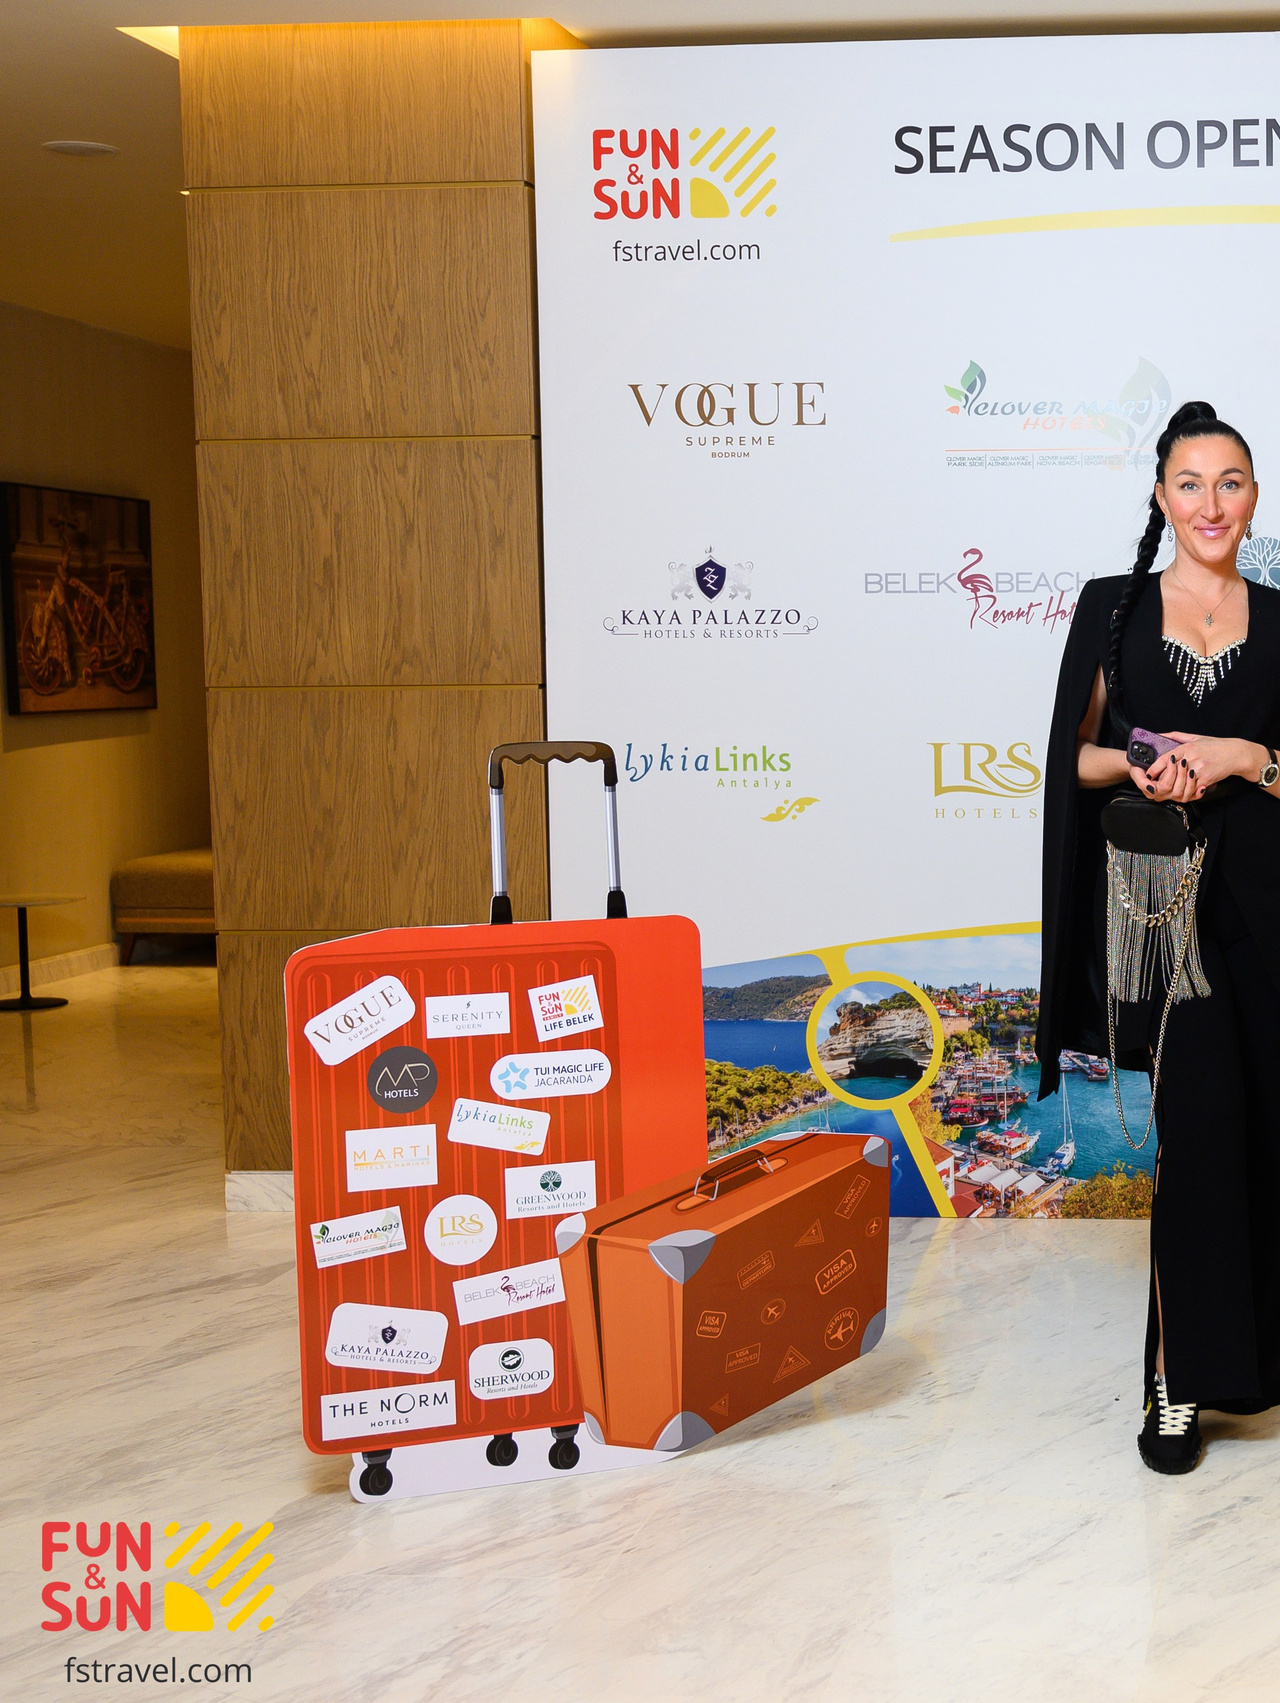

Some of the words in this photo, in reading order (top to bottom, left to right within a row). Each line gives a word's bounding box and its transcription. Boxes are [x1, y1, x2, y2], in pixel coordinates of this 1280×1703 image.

[592, 128, 680, 171] FUN
[894, 121, 1125, 175] SEASON
[627, 163, 644, 185] &
[612, 239, 761, 262] fstravel.com
[627, 381, 827, 428] VOGUE
[974, 401, 1064, 416] CLOVER
[685, 436, 776, 447] SUPREME
[711, 451, 750, 459] BODRUM
[864, 572, 958, 594] BELEK
[621, 609, 683, 625] KAYA
[691, 608, 801, 625] PALAZZO
[643, 629, 696, 639] HOTELS
[703, 628, 713, 639] &
[719, 629, 779, 639] RESORTS
[926, 742, 1044, 798] LRS
[716, 777, 792, 790] Antalya
[934, 808, 1038, 819] HOTELS
[538, 991, 561, 1005] FUN
[313, 985, 402, 1044] VOGUE
[432, 1010, 503, 1023] SERENITY
[544, 1020, 564, 1032] LIFE
[565, 1013, 595, 1027] BELEK
[534, 1067, 550, 1076] TUI
[552, 1064, 583, 1074] MAGIC
[585, 1062, 604, 1072] LIFE
[534, 1074, 594, 1087] JACARANDA
[384, 1088, 419, 1099] HOTELS
[353, 1144, 430, 1162] MARTI
[516, 1190, 587, 1205] GREENWOOD
[517, 1205, 545, 1213] Resorts
[822, 1263, 853, 1290] APPROVED
[823, 1259, 847, 1279] VISA
[464, 1286, 502, 1303] BELEK
[515, 1274, 556, 1291] BEACH
[704, 1315, 720, 1326] VISA
[826, 1310, 854, 1335] ARRIVAL
[340, 1343, 371, 1355] KAYA
[375, 1347, 429, 1360] PALAZZO
[474, 1369, 550, 1388] SHERWOOD
[329, 1401, 369, 1418] THE
[380, 1392, 449, 1415] NORM
[370, 1417, 410, 1428] HOTELS
